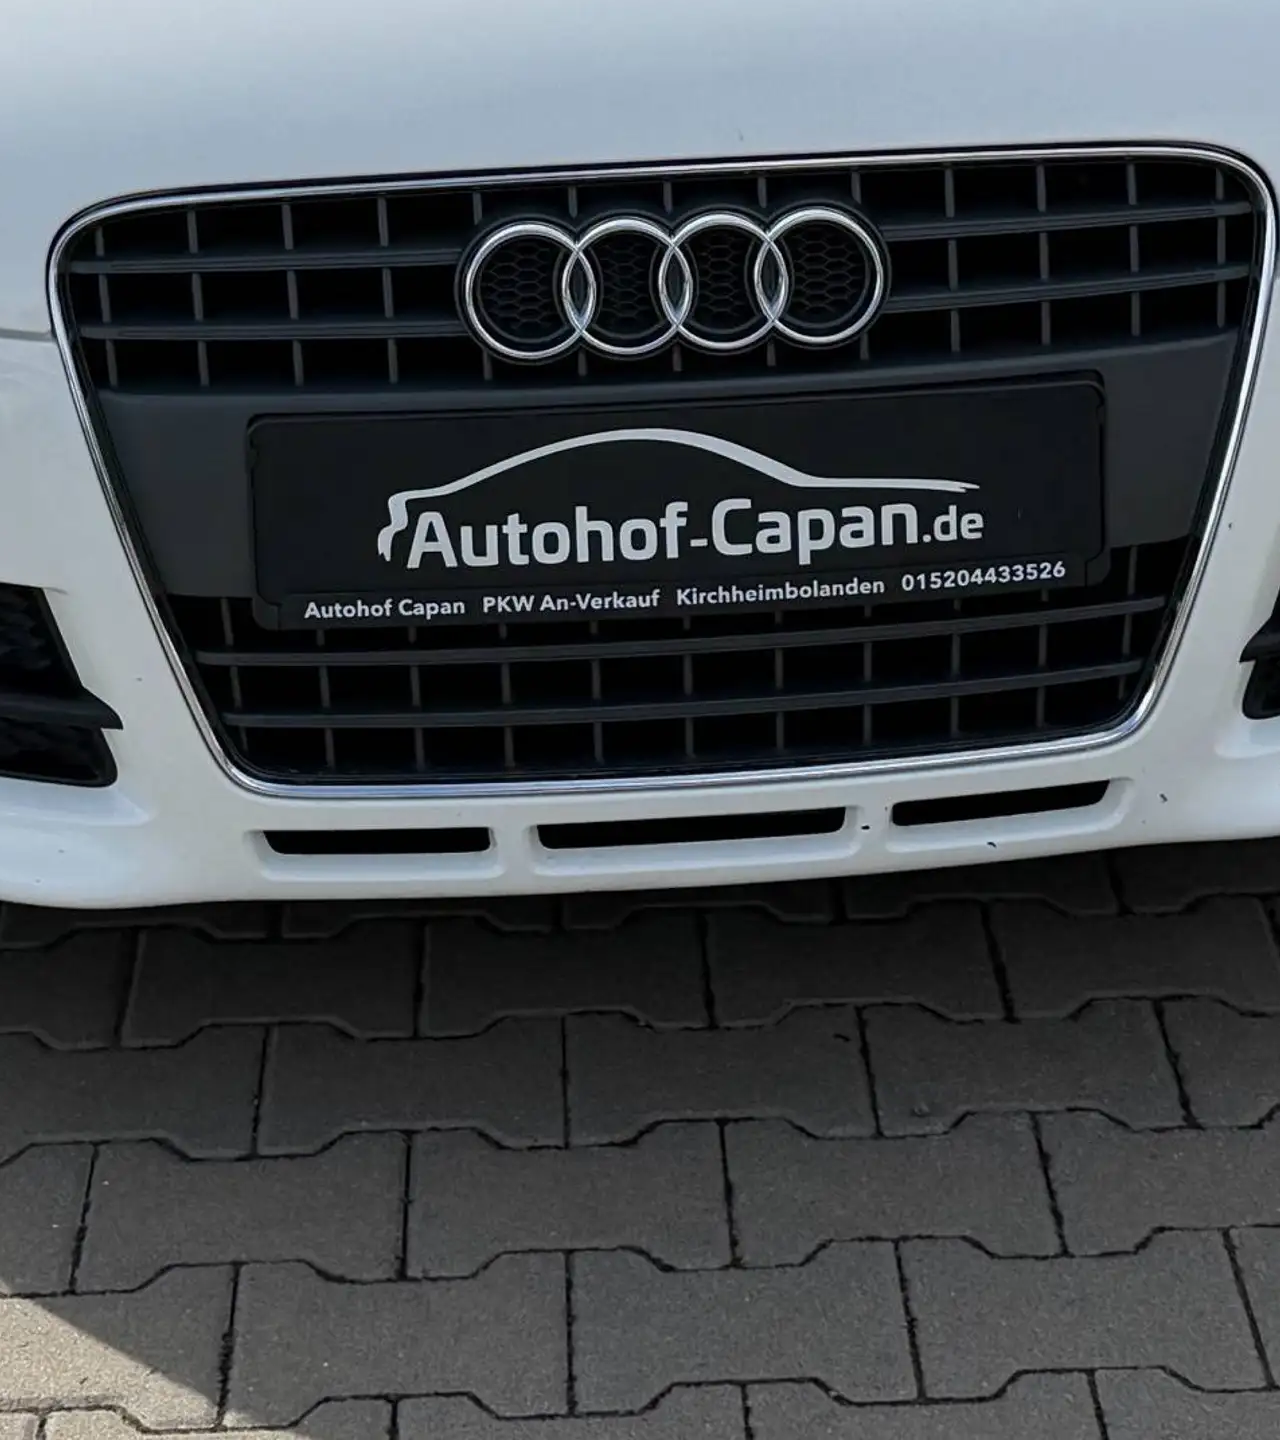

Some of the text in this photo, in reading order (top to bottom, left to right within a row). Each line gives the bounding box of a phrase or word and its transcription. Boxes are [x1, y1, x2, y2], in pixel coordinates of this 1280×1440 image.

[407, 498, 984, 566] Autohof-Capan.de
[305, 561, 1065, 619] Autohof Capan PKW An-Verkauf Kirchheimbolanden 015204433526
